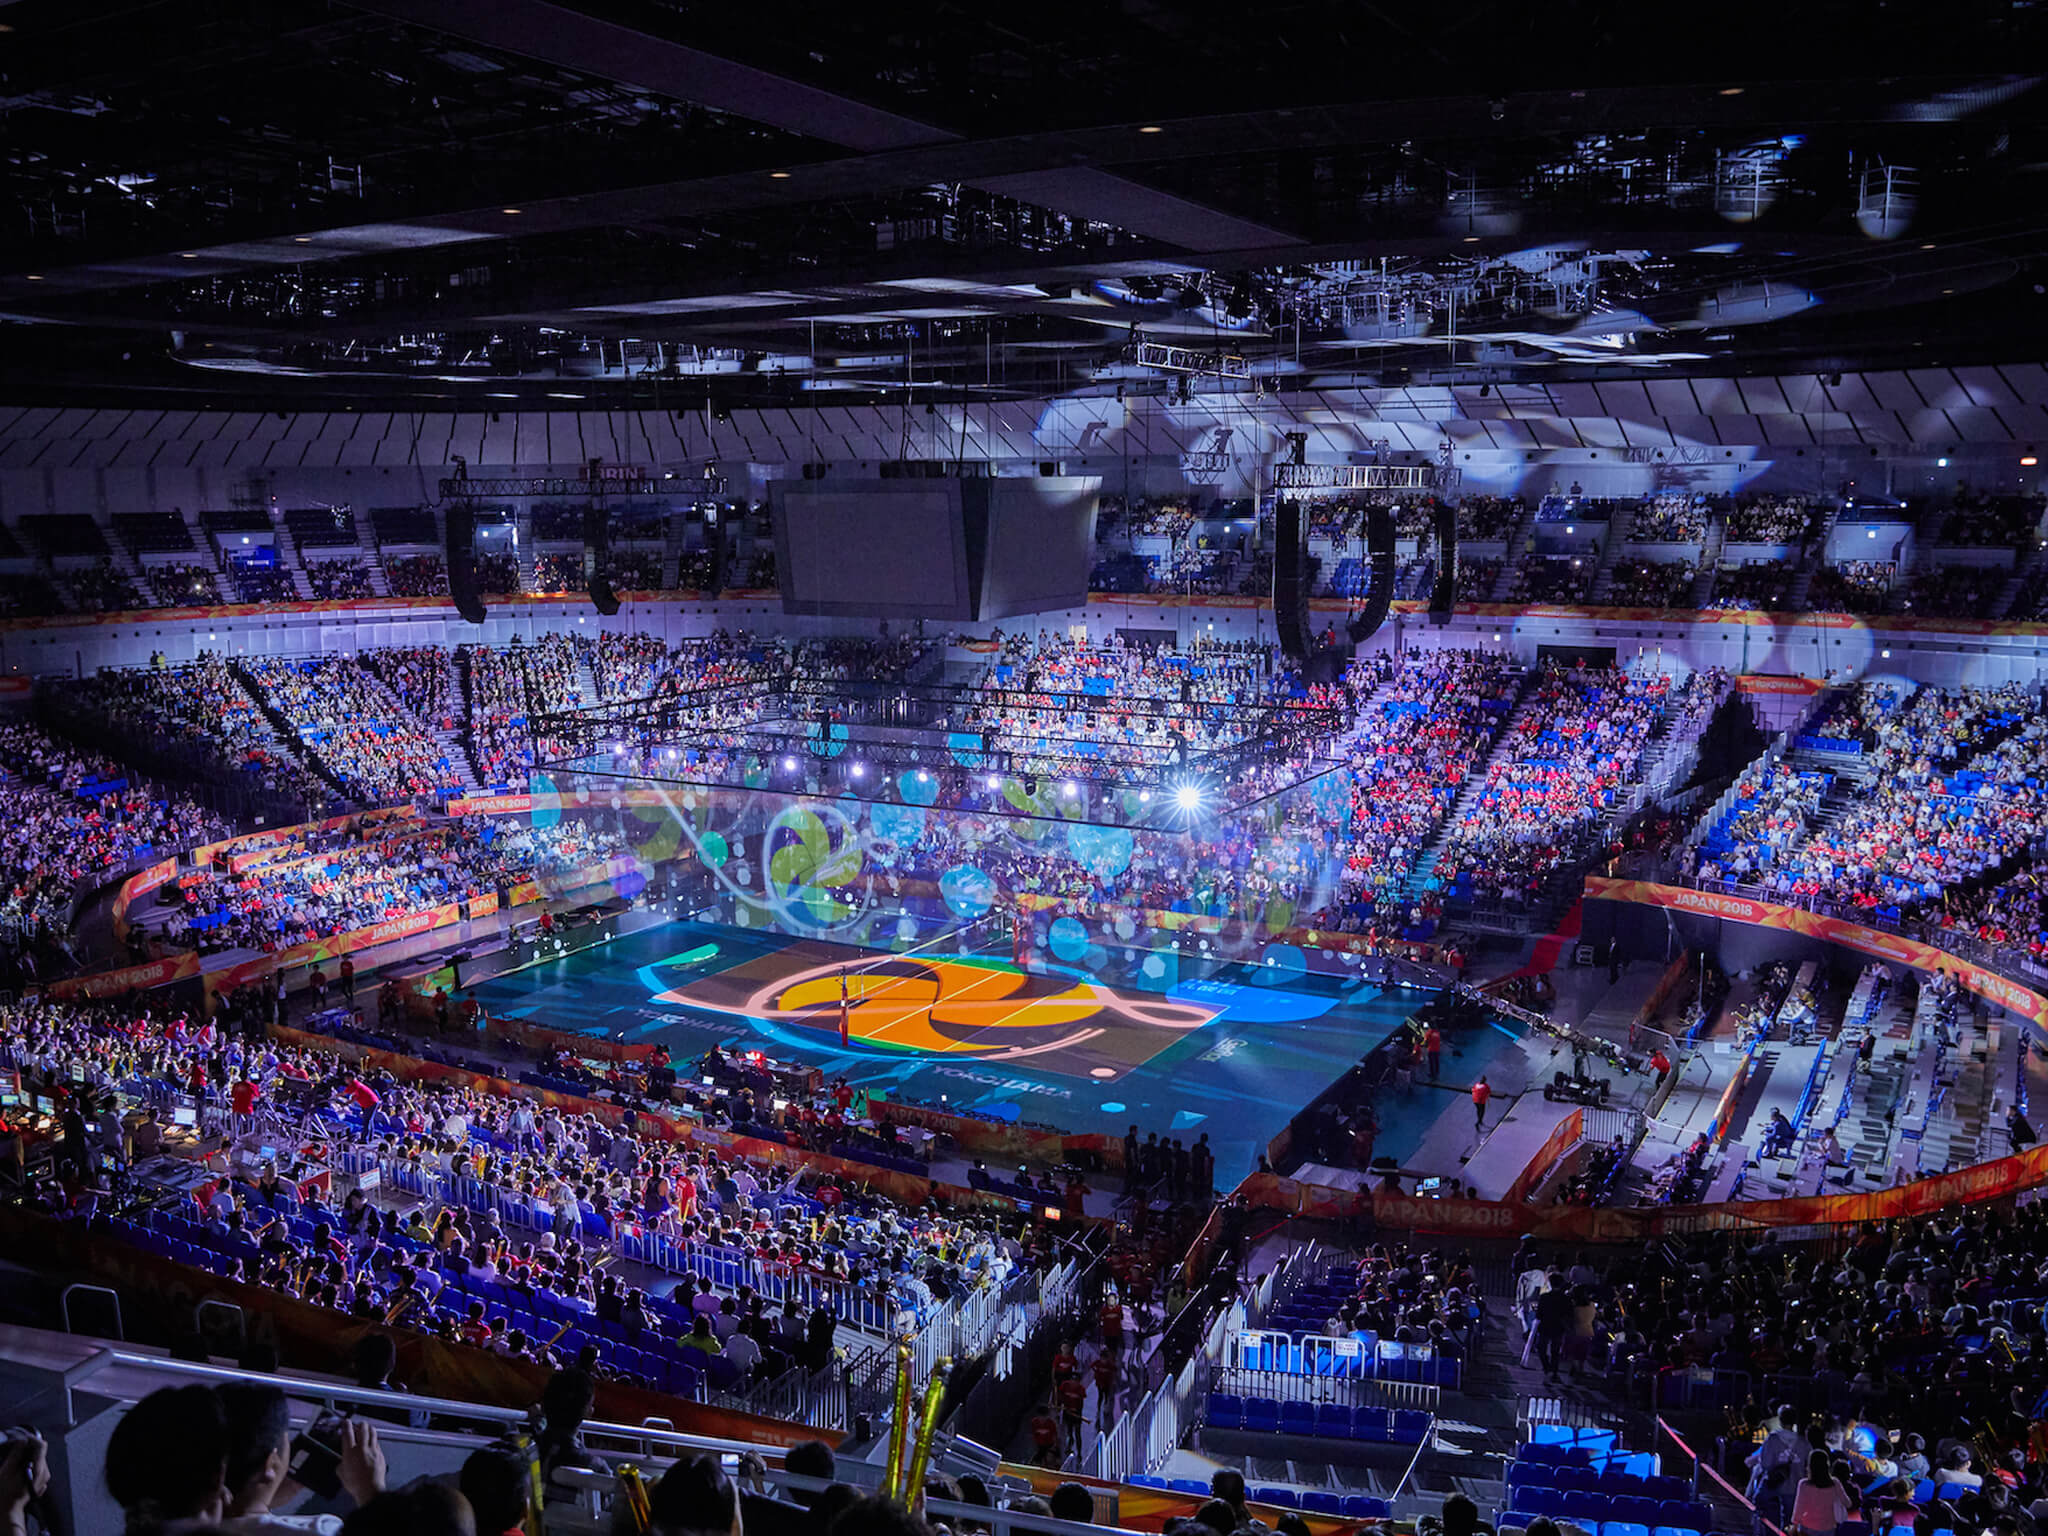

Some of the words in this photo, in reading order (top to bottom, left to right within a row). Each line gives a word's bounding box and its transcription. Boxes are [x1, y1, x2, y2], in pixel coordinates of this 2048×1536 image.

[470, 799, 505, 812] JAPAN
[507, 797, 531, 810] 2018
[469, 896, 499, 914] JAPAN
[1674, 894, 1720, 912] JAPAN
[1722, 900, 1754, 917] 2018
[372, 920, 406, 940] JAPAN
[408, 914, 430, 930] 2018
[131, 964, 164, 985] 2018
[1970, 972, 2006, 996] JAPAN
[2008, 987, 2032, 1010] 2018
[1919, 1176, 1974, 1205] JAPAN
[1975, 1164, 2009, 1189] 2018
[1459, 1205, 1514, 1228] 2018
